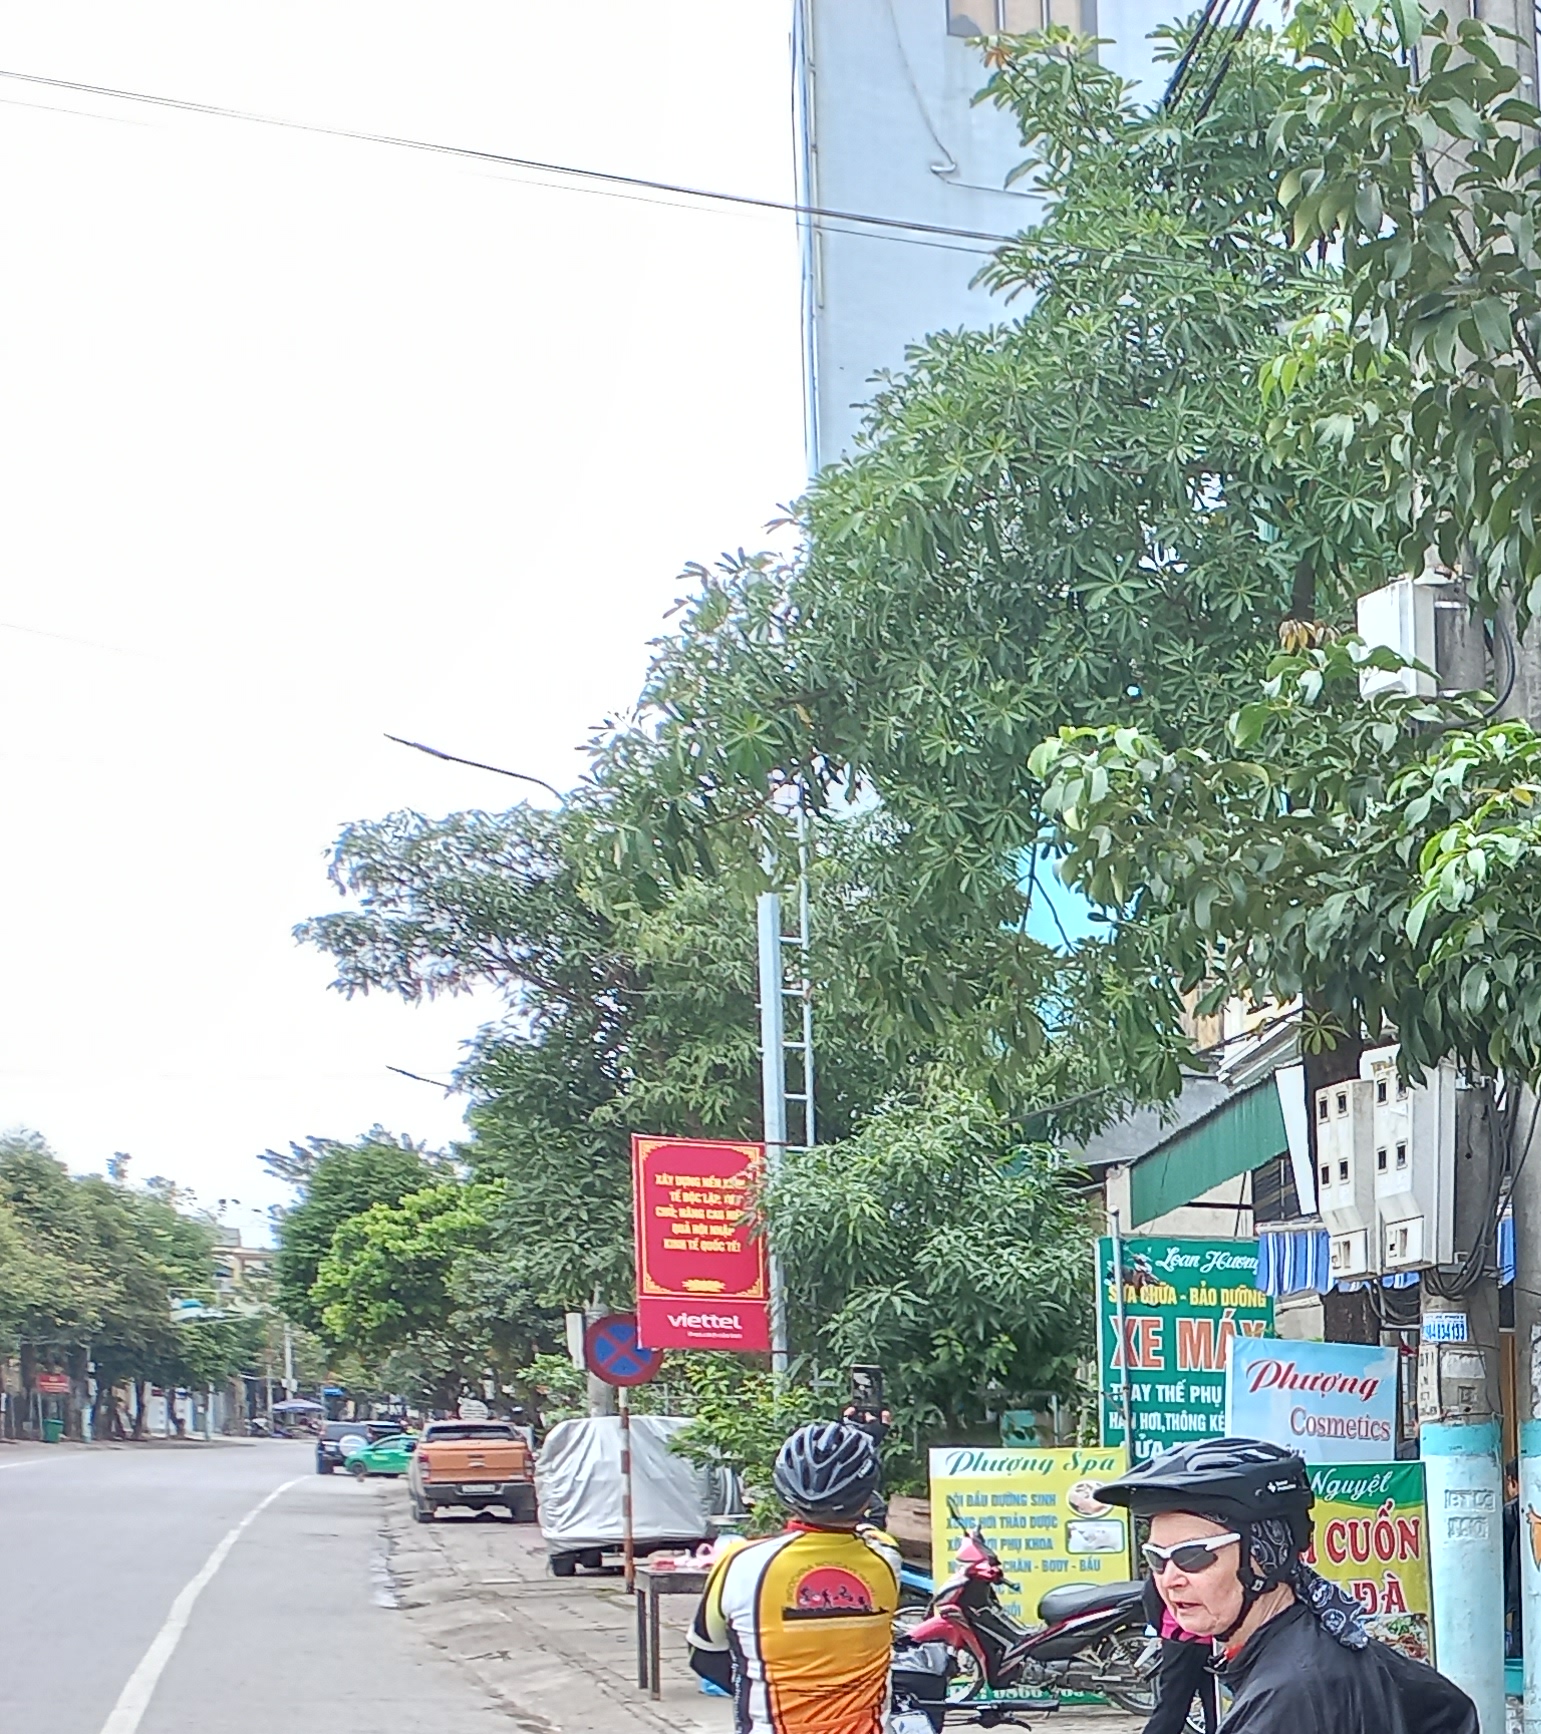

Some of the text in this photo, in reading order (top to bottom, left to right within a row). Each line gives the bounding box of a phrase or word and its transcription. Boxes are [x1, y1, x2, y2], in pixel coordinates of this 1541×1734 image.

[1155, 1246, 1200, 1272] Loan
[1189, 1280, 1217, 1304] BẢO
[667, 1312, 743, 1330] viettel
[1109, 1314, 1165, 1371] XE
[1246, 1358, 1382, 1402] Phượng
[1110, 1379, 1222, 1408] TAY THẾ PHỤ
[1291, 1406, 1391, 1441] Cosmetics
[945, 1450, 1116, 1476] Phượng Spa
[1030, 1494, 1056, 1507] SINH
[1024, 1537, 1054, 1551] KHOA
[1326, 1498, 1421, 1564] CUỐN
